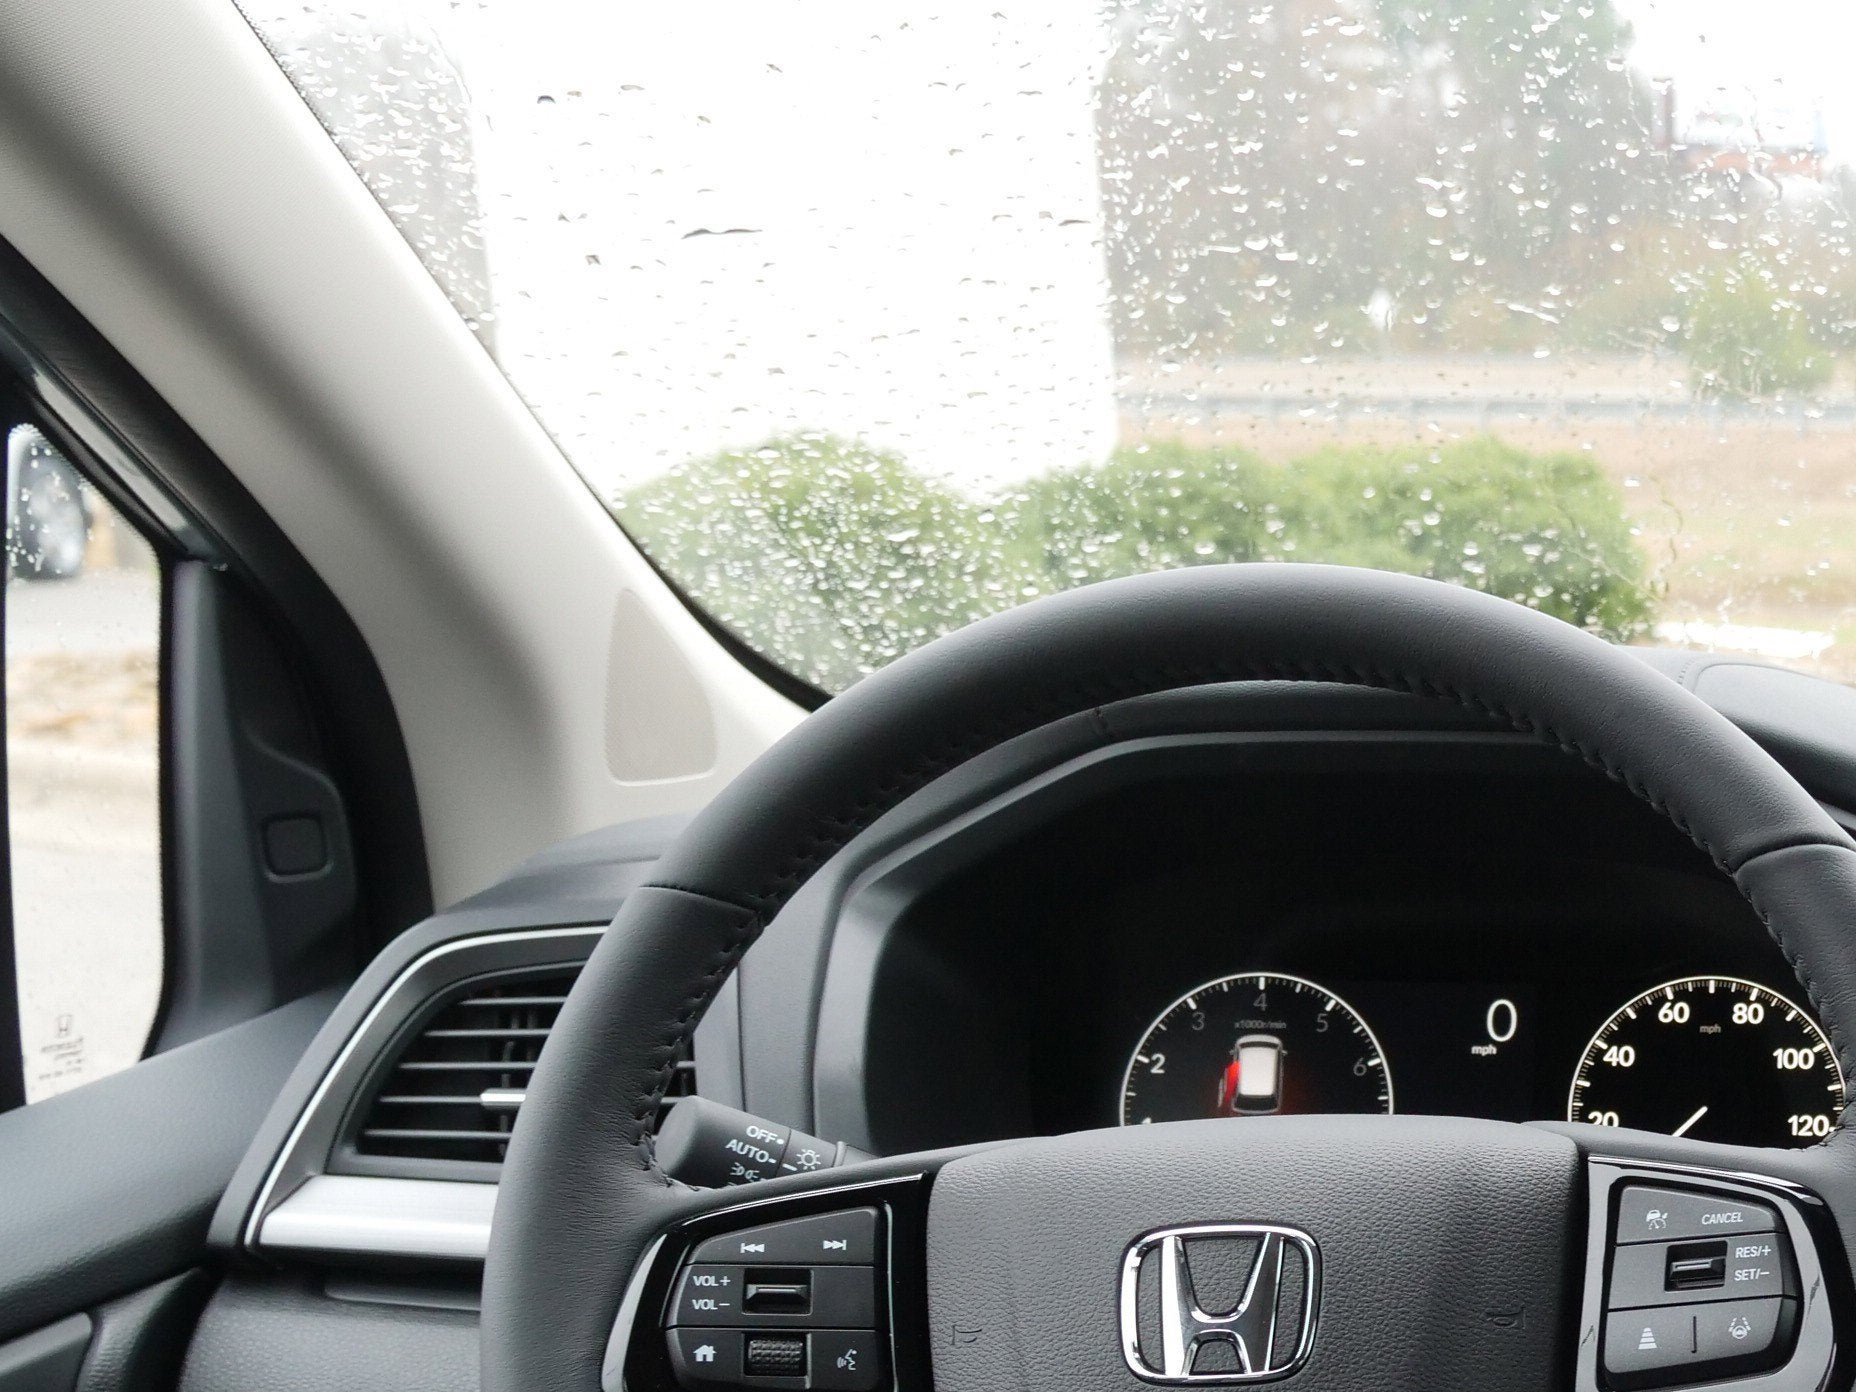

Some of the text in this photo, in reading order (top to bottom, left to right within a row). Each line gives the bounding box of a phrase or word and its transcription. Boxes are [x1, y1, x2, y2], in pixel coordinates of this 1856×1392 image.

[1253, 993, 1268, 1011] 4
[1192, 1012, 1205, 1031] 3
[1316, 1013, 1329, 1032] 5
[1486, 999, 1518, 1042] 0
[1658, 1002, 1690, 1024] 60
[1732, 1003, 1765, 1025] 80
[1700, 1024, 1721, 1035] mph
[1471, 1044, 1497, 1058] mph
[1603, 1046, 1635, 1067] 40
[1773, 1048, 1815, 1070] 100
[1151, 1053, 1165, 1074] 2
[1354, 1058, 1367, 1076] 6
[1588, 1111, 1619, 1127] 20
[1787, 1115, 1829, 1137] 120
[746, 1125, 777, 1145] OFF
[725, 1139, 768, 1164] AUTO
[1701, 1212, 1743, 1226] CANCEL
